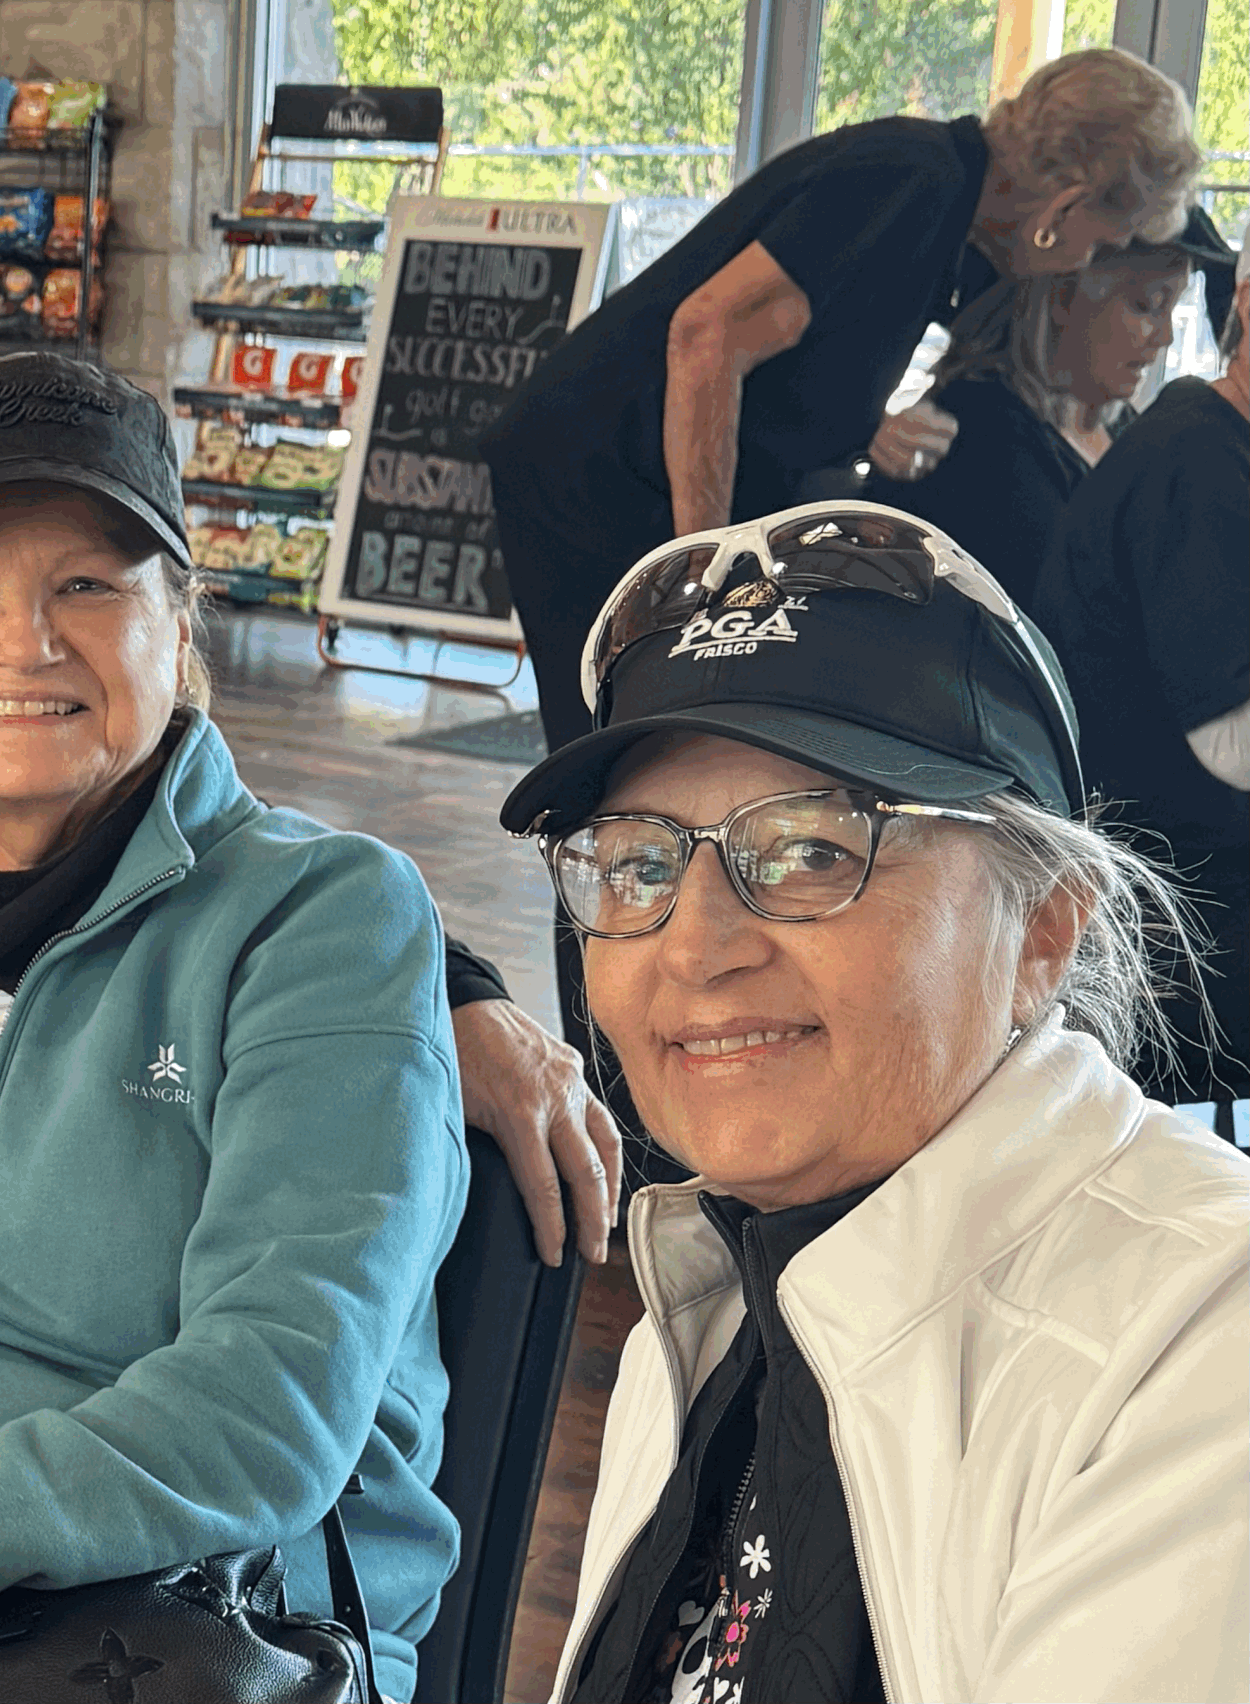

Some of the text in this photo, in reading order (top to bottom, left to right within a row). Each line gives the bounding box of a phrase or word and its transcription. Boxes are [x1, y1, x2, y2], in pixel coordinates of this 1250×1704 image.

[501, 208, 577, 235] ULTRA
[404, 242, 550, 299] BEHIND
[425, 296, 524, 339] EVERY
[355, 531, 488, 614] BEER
[671, 609, 798, 652] PGA
[693, 642, 757, 661] FRISCO
